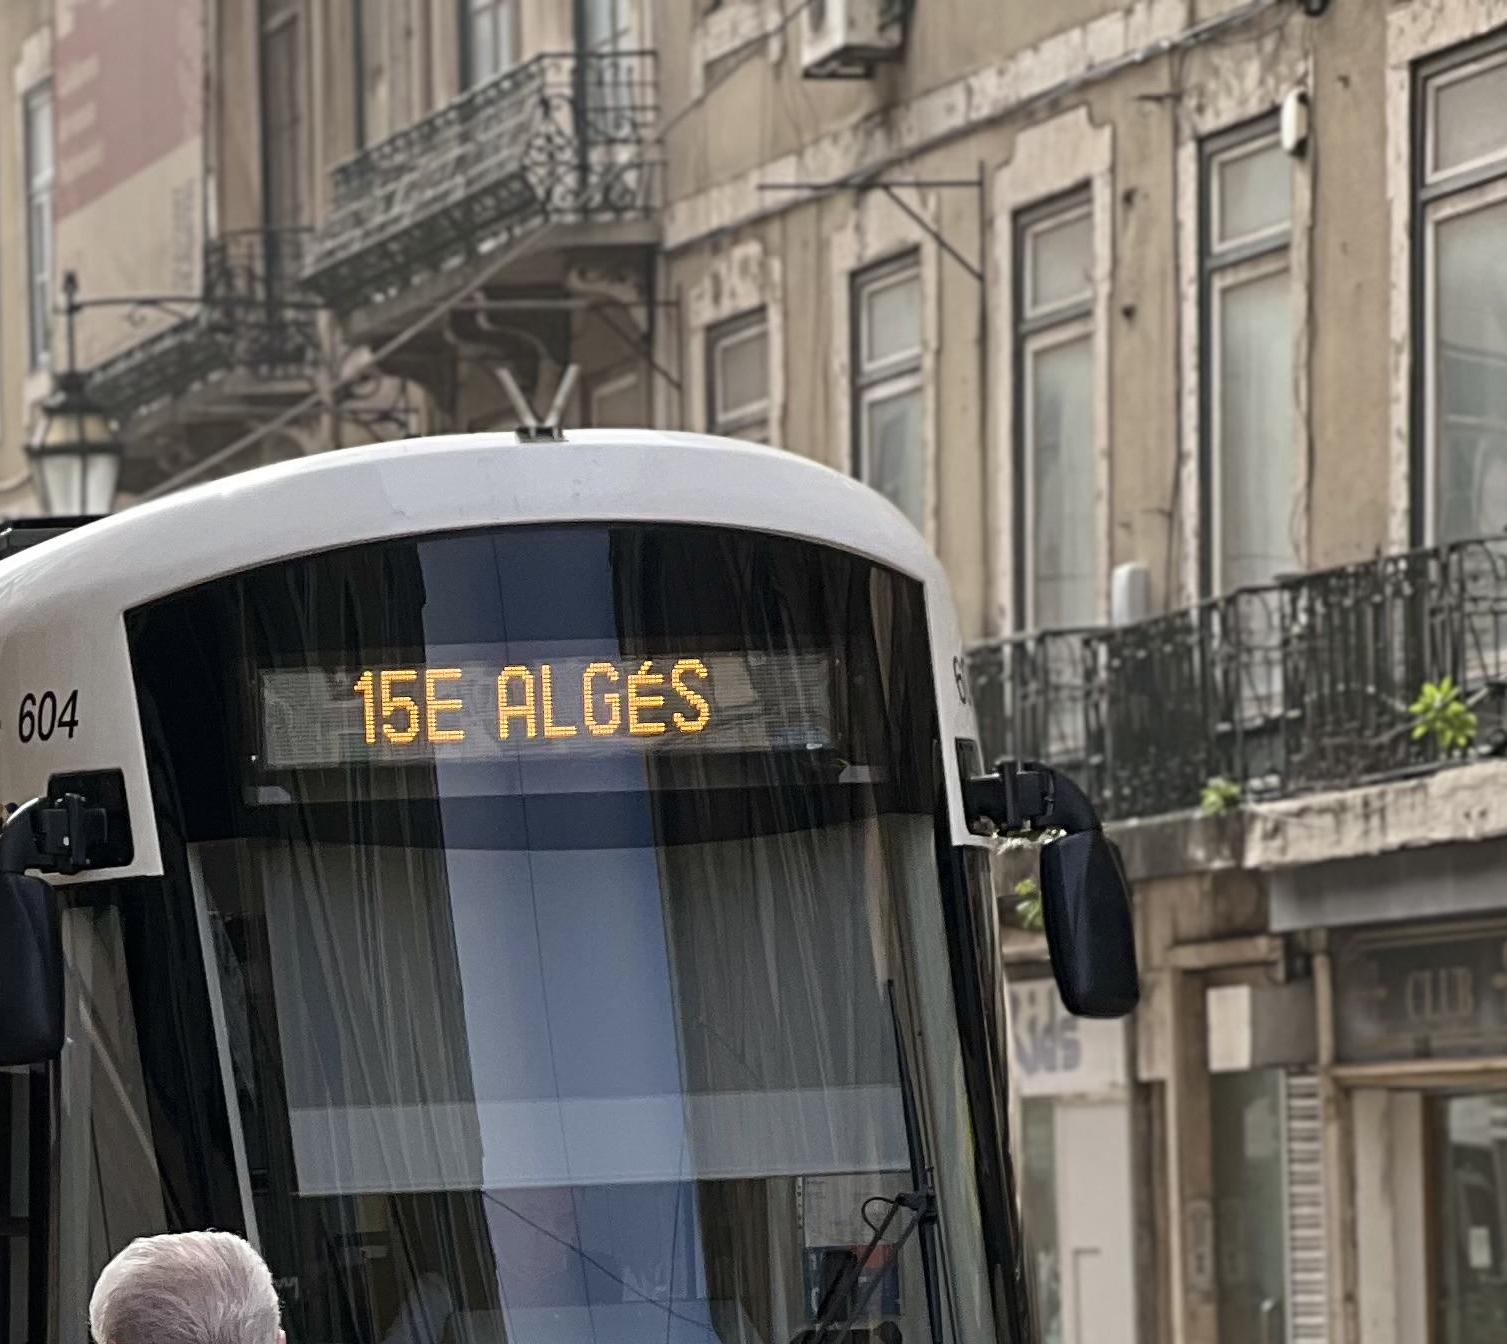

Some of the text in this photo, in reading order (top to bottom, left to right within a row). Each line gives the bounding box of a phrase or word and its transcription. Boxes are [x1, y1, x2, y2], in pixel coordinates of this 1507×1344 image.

[18, 689, 79, 743] 604
[353, 658, 710, 743] 15E ALGÉS
